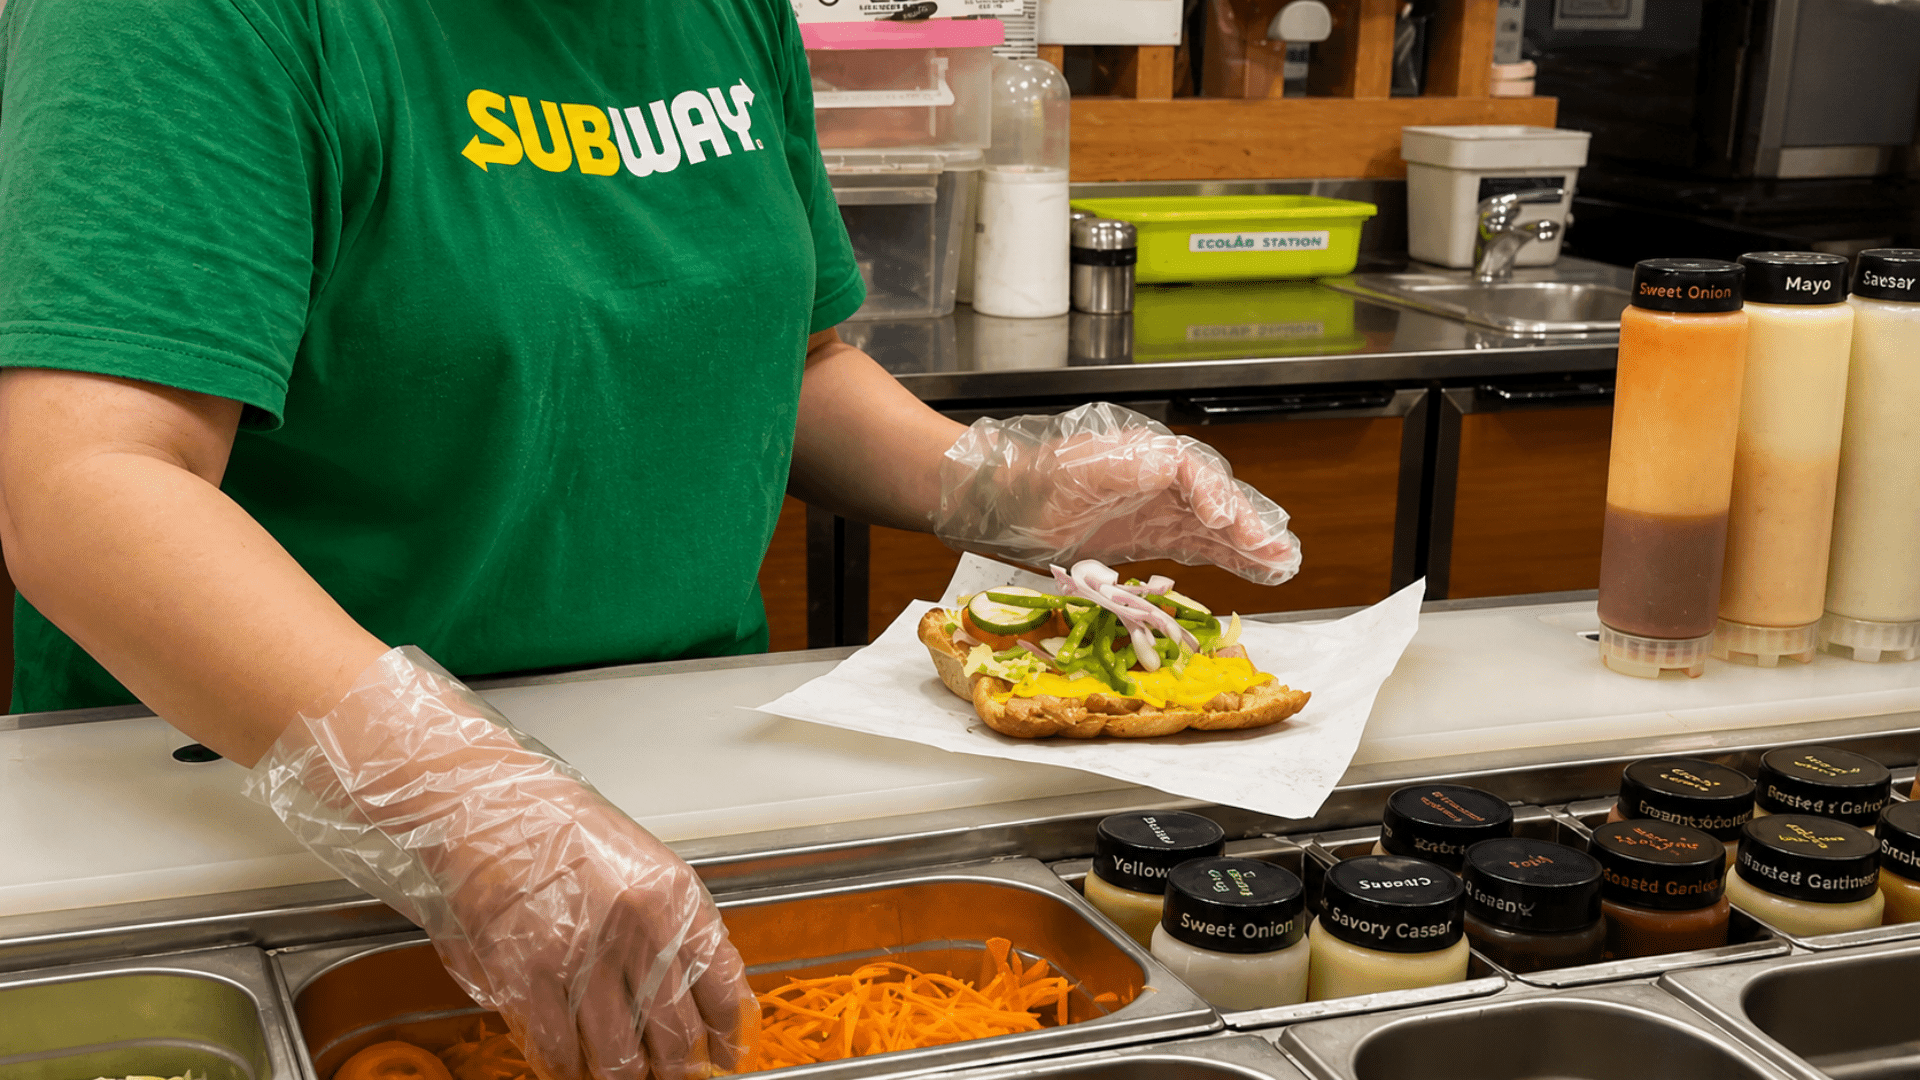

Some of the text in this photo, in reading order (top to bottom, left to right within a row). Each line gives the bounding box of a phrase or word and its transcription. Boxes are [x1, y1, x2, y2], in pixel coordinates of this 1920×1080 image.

[461, 78, 757, 178] SUBWAY
[1262, 236, 1322, 248] STATION
[1639, 281, 1732, 300] Sweet Onion
[1785, 275, 1832, 296] Mayo
[1113, 854, 1171, 879] Yellow
[1180, 912, 1294, 940] Sweet Onion
[1331, 907, 1391, 940] Savory
